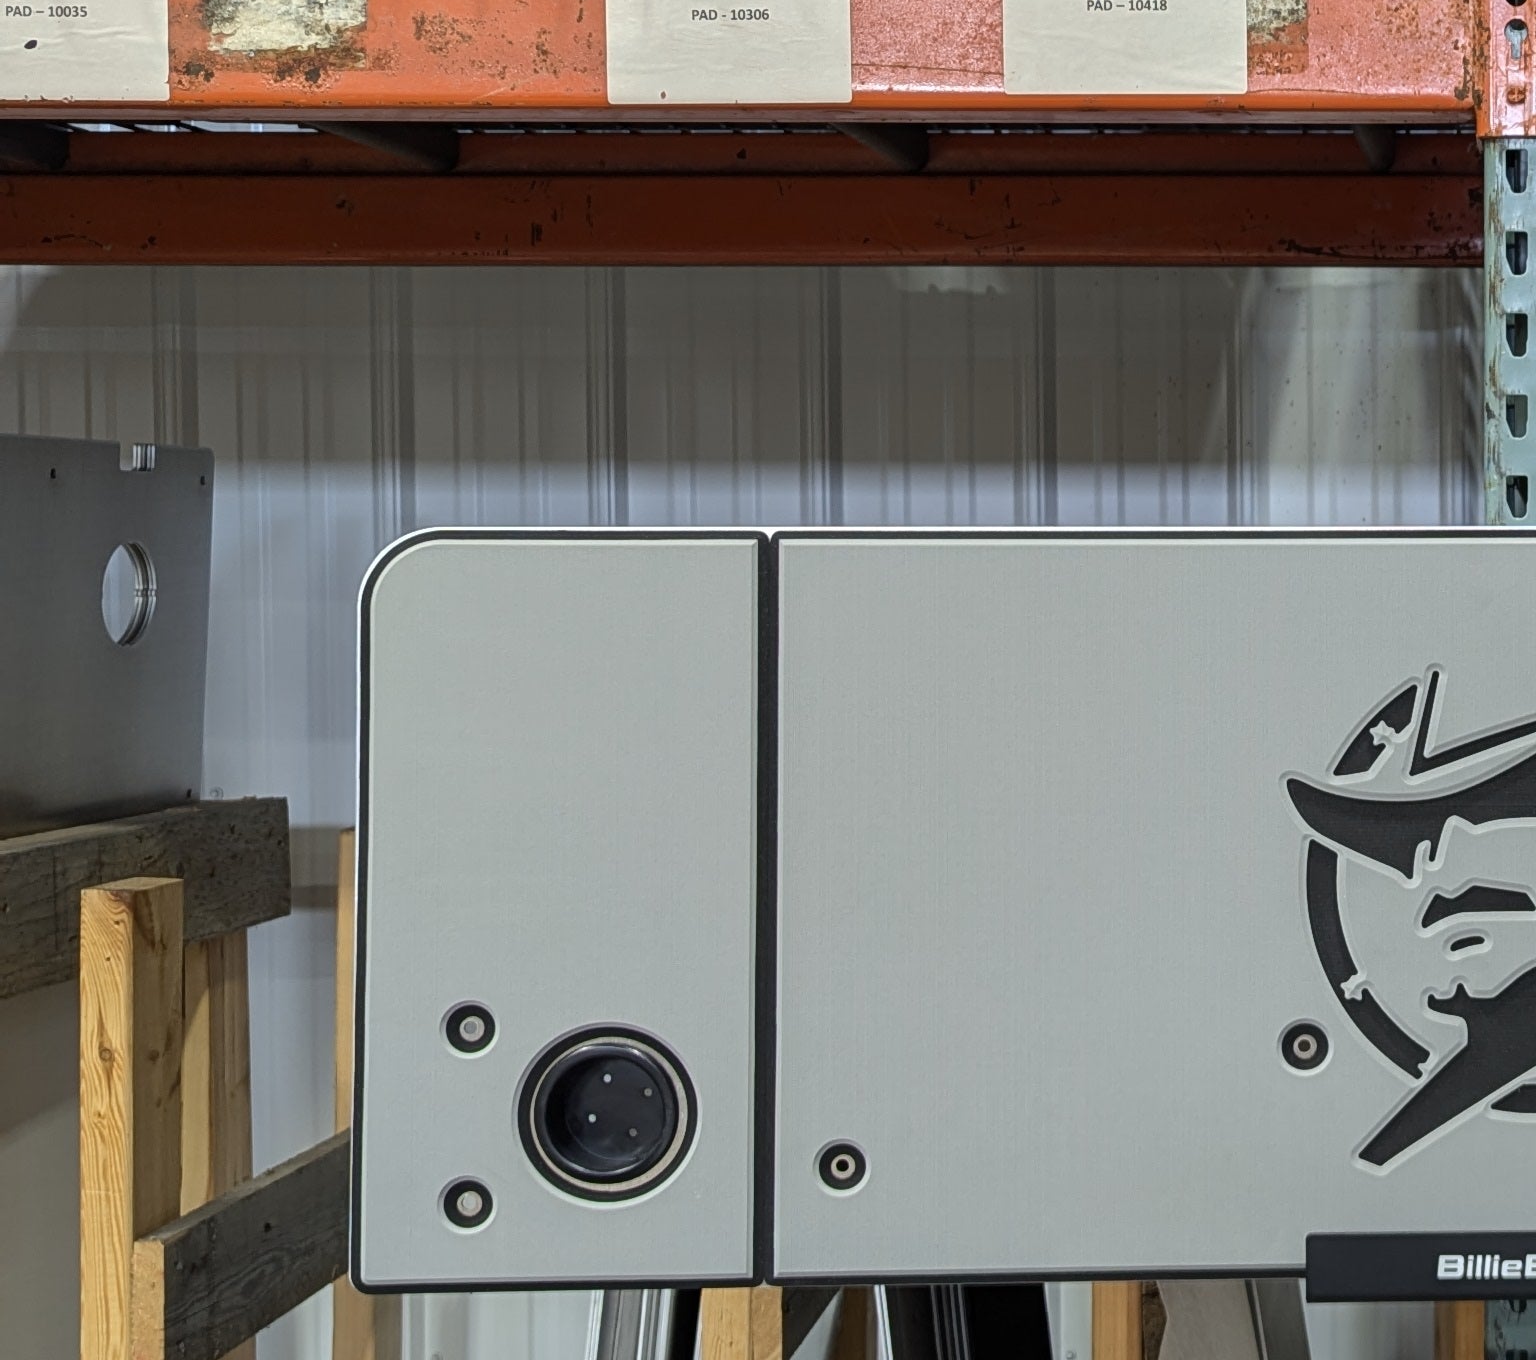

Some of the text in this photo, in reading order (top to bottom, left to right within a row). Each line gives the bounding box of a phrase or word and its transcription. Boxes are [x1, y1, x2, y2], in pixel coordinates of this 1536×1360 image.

[1086, 0, 1112, 11] PAD
[1128, 0, 1168, 11] 10418
[5, 6, 32, 17] PAD
[48, 6, 88, 17] 10035
[691, 9, 718, 21] PAD
[730, 9, 770, 21] 10306
